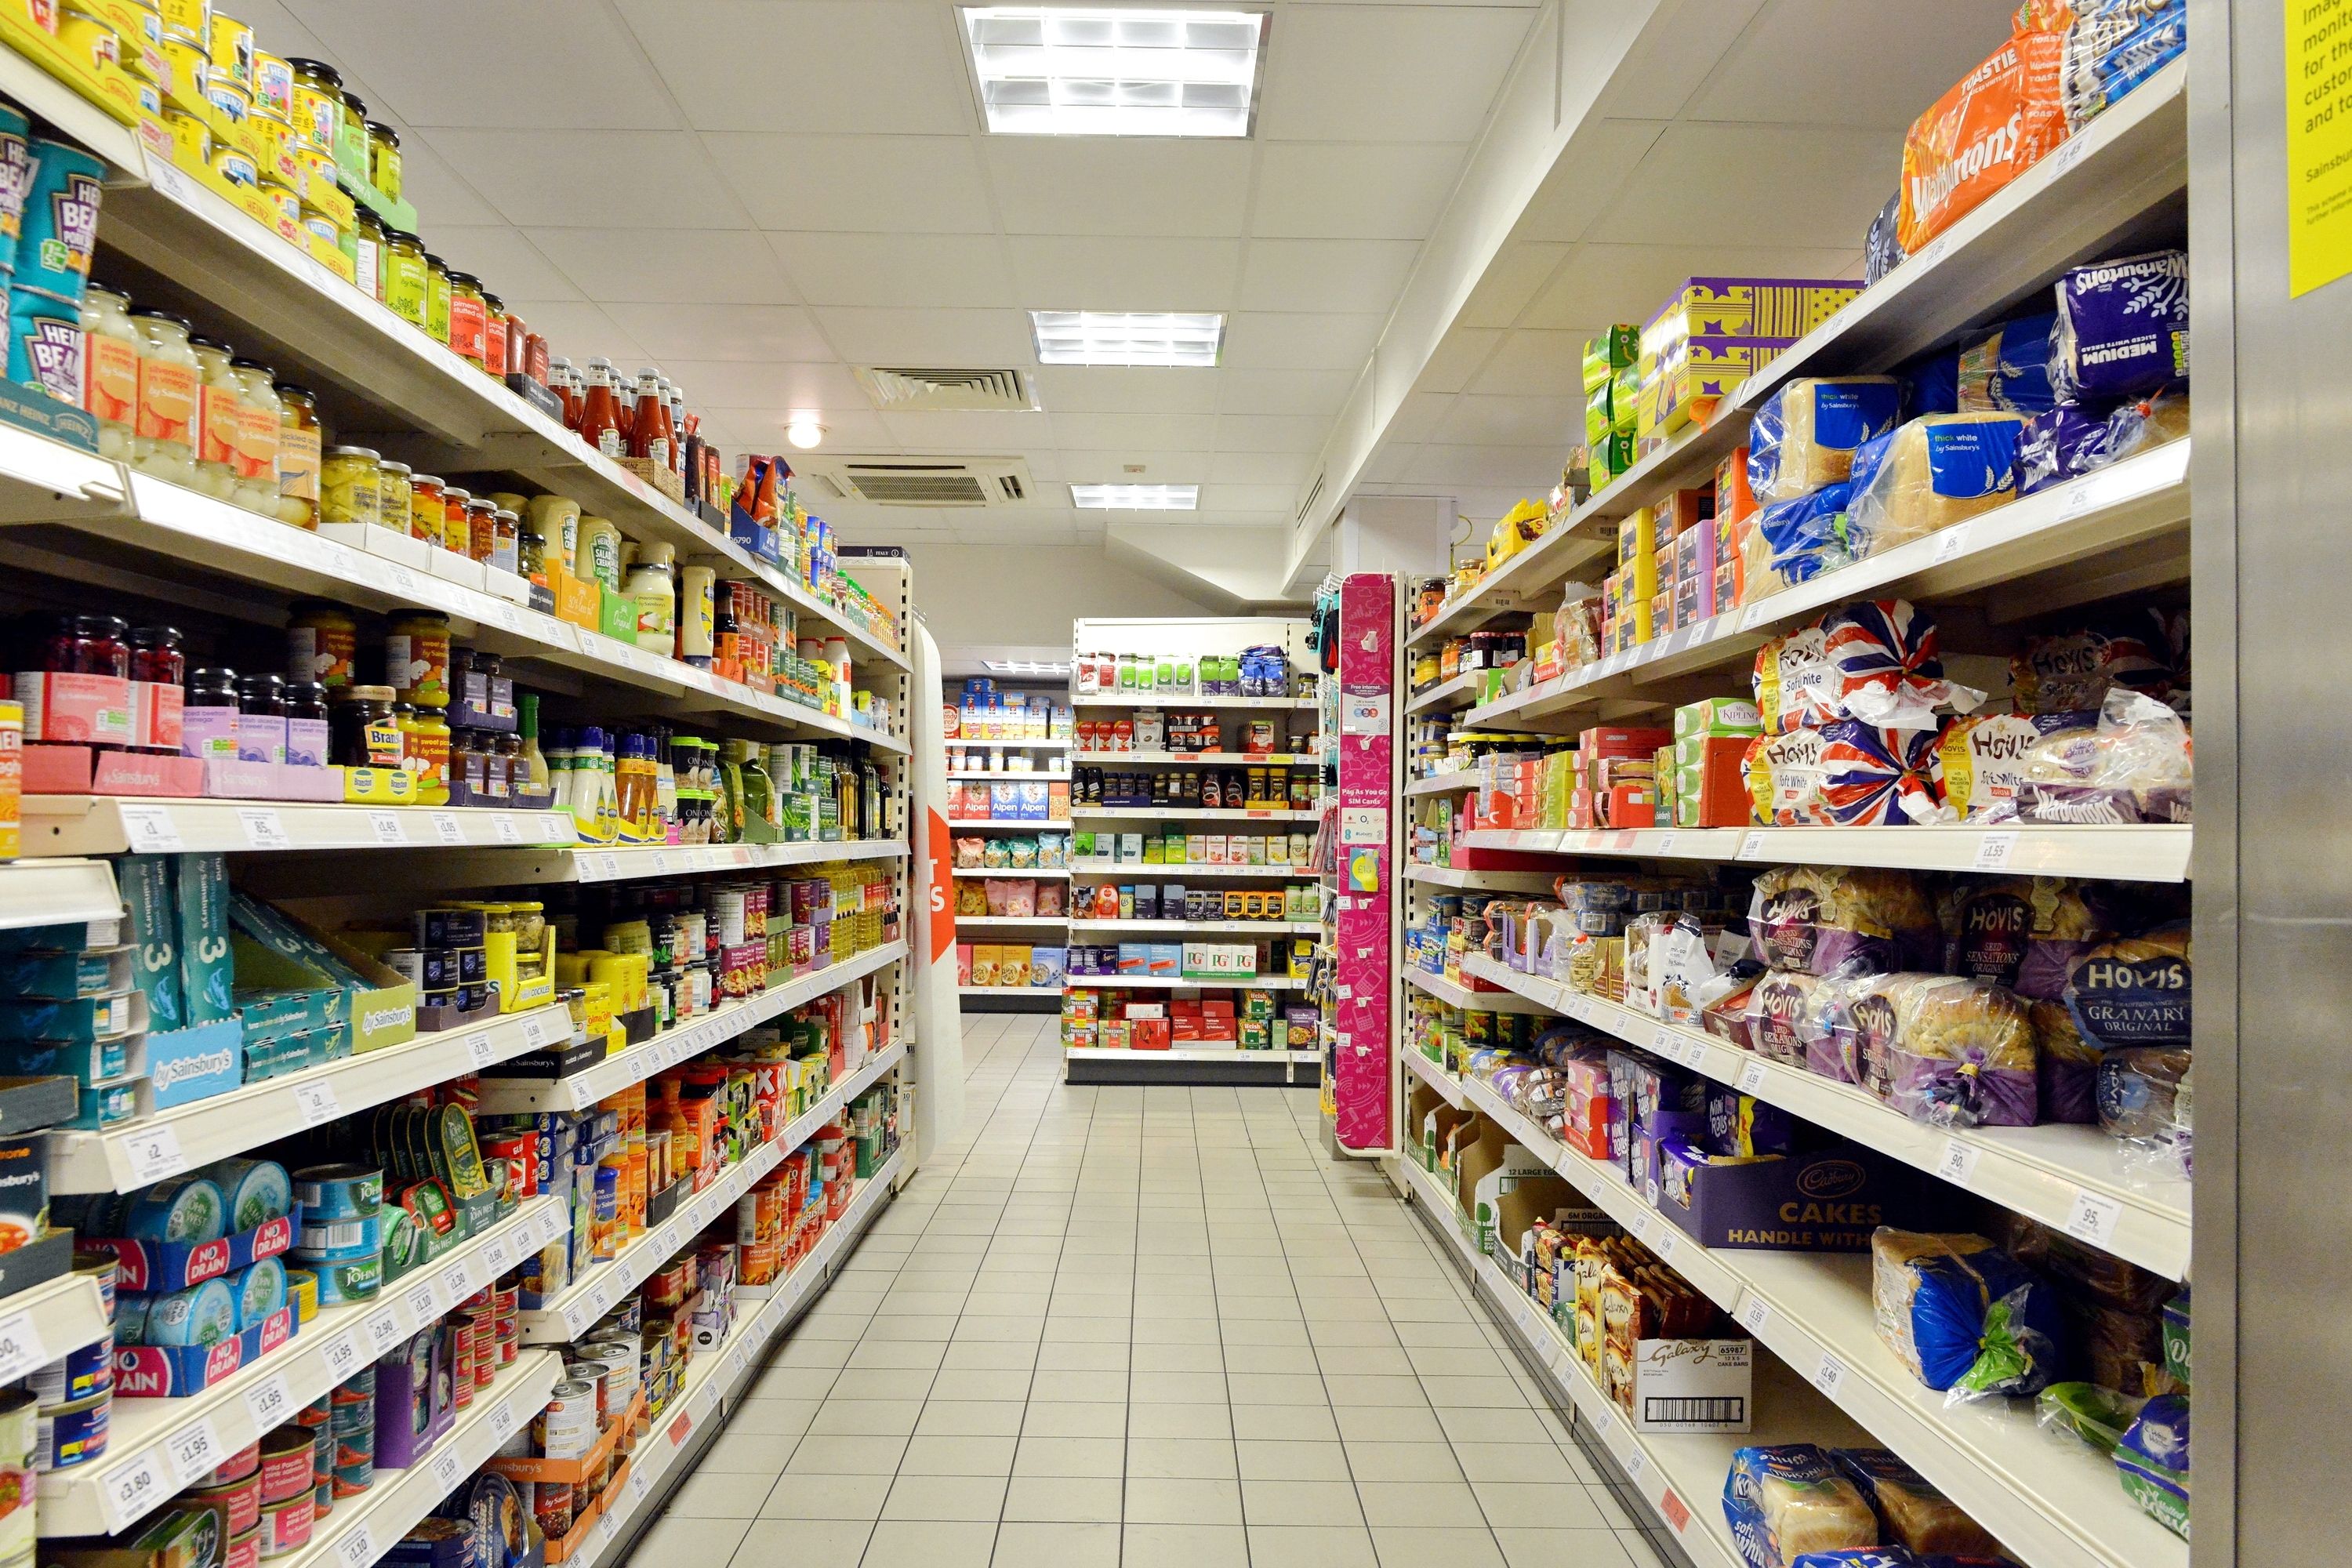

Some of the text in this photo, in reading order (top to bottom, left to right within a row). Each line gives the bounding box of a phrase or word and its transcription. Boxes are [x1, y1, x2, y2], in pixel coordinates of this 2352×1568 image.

[1961, 47, 2018, 96] TOASTIE
[2304, 55, 2325, 78] for
[212, 92, 241, 110] HEINZ
[2305, 103, 2333, 132] and
[1911, 112, 2022, 224] Warburtons
[245, 198, 270, 221] HEINZ
[325, 198, 346, 217] HEINZ
[328, 259, 347, 275] HEINZ
[2075, 252, 2188, 296] Warburtons
[453, 300, 480, 312] pimento
[453, 307, 475, 317] stuffed
[2082, 334, 2157, 352] SLICED WHITE BREAD
[2082, 341, 2158, 366] MEDIUM
[1719, 709, 1759, 721] KIPLING
[965, 804, 989, 812] Alpen
[993, 804, 1017, 812] Alpen
[1021, 804, 1046, 812] Alpen
[1969, 906, 2024, 931] HOVIS
[143, 942, 172, 972] 3
[198, 935, 227, 964] 3
[1187, 953, 1202, 964] PG
[1965, 950, 2020, 964] SENSATIONS
[1212, 954, 1228, 967] PG
[1236, 955, 1251, 967] PG
[2088, 964, 2184, 989] HOVIS
[531, 985, 550, 996] COCKLES
[364, 1006, 411, 1034] by Sainsbury's
[2088, 1005, 2185, 1021] GRANARY
[2104, 1021, 2172, 1032] ORIGINAL
[474, 1044, 488, 1054] £2.70
[153, 1052, 230, 1085] by Sainsbury's
[515, 1059, 554, 1068] Sainsbury's
[1779, 1202, 1882, 1225] CAKES
[264, 1224, 281, 1239] NO
[1728, 1229, 1812, 1245] HANDLE
[256, 1234, 289, 1255] DRAIN
[199, 1247, 217, 1262] NO
[488, 1249, 503, 1264] £1.60
[191, 1256, 227, 1279] DRAIN
[347, 1267, 376, 1287] JOHN
[451, 1272, 466, 1290] £1.30
[416, 1295, 431, 1312] £1.10
[269, 1316, 281, 1328] NO
[374, 1320, 393, 1339] £2.90
[264, 1323, 289, 1345] DRAIN
[217, 1345, 231, 1358] NO
[332, 1345, 351, 1366] £1.95
[1638, 1342, 1717, 1367] Galaxy
[209, 1356, 239, 1377] DRAIN
[1821, 1367, 1837, 1382] £1.40
[258, 1389, 282, 1414] £1.95
[180, 1437, 209, 1464] £1.95
[119, 1471, 151, 1500] £3.80
[1734, 1520, 1753, 1538] soft
[350, 1539, 368, 1562] £1.10
